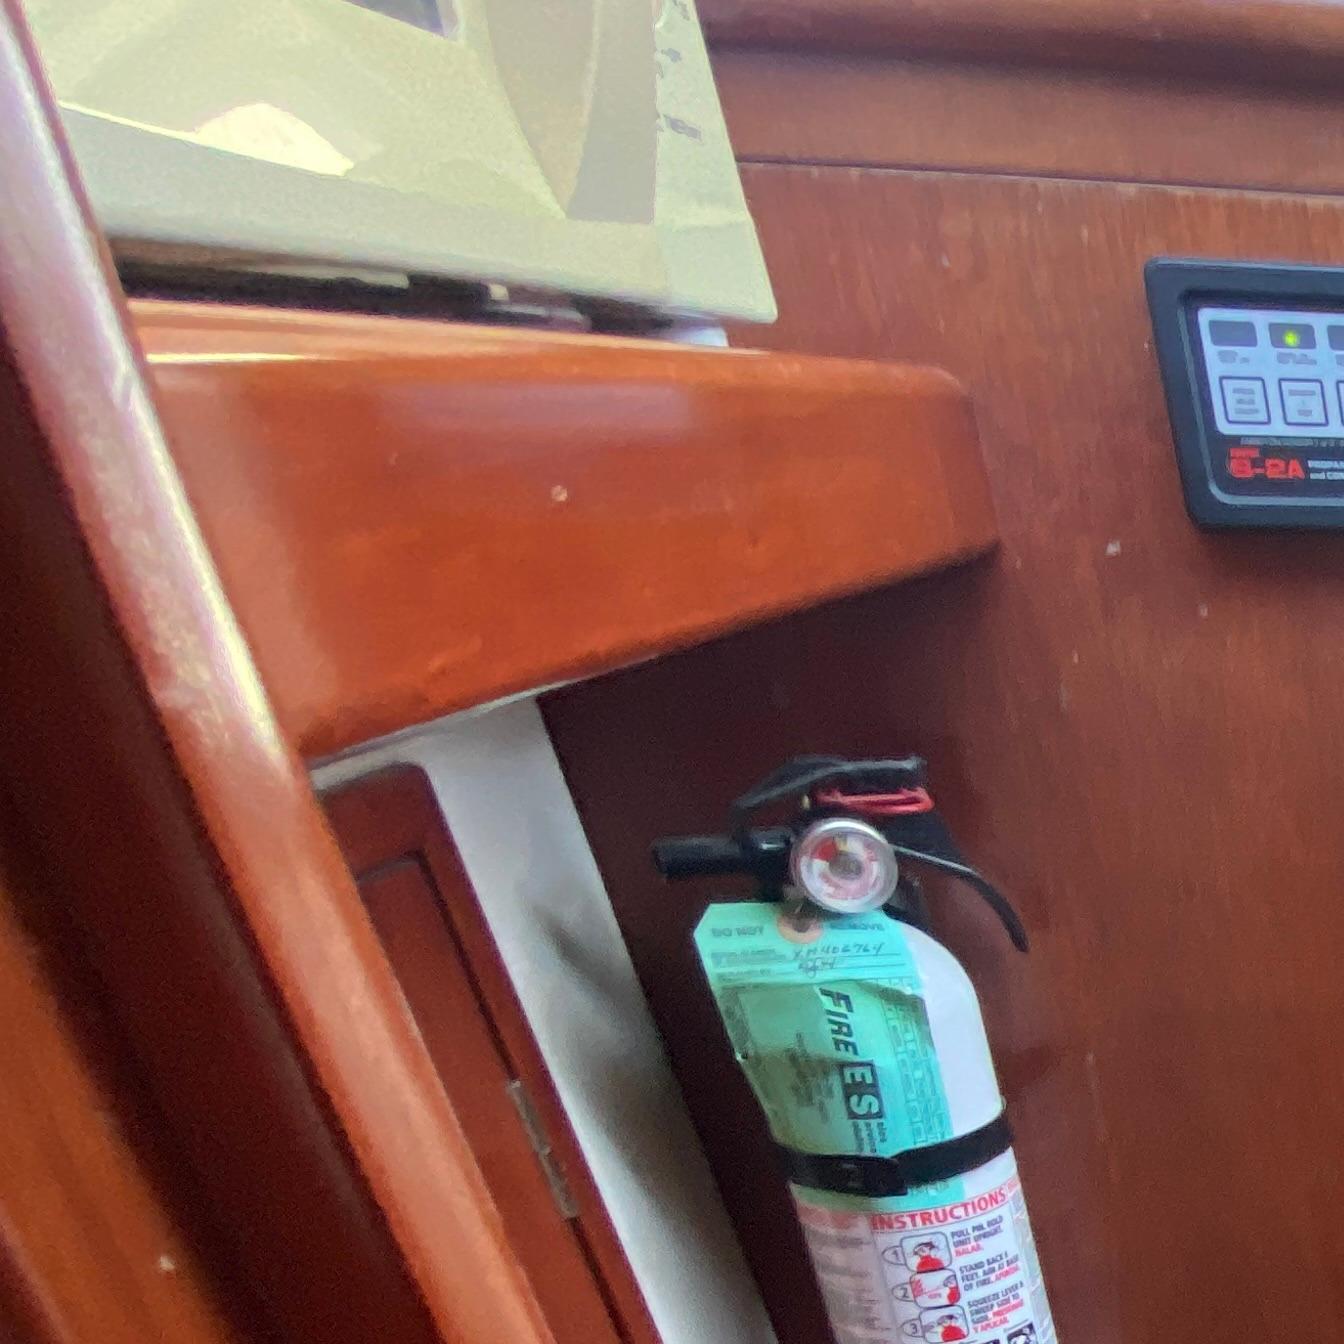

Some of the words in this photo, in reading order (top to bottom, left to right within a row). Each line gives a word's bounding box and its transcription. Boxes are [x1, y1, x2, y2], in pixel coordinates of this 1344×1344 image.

[819, 987, 860, 1056] FIRE
[843, 1066, 880, 1115] ES
[872, 1188, 1006, 1230] INSTRUCTIONS
[900, 1287, 910, 1298] 2
